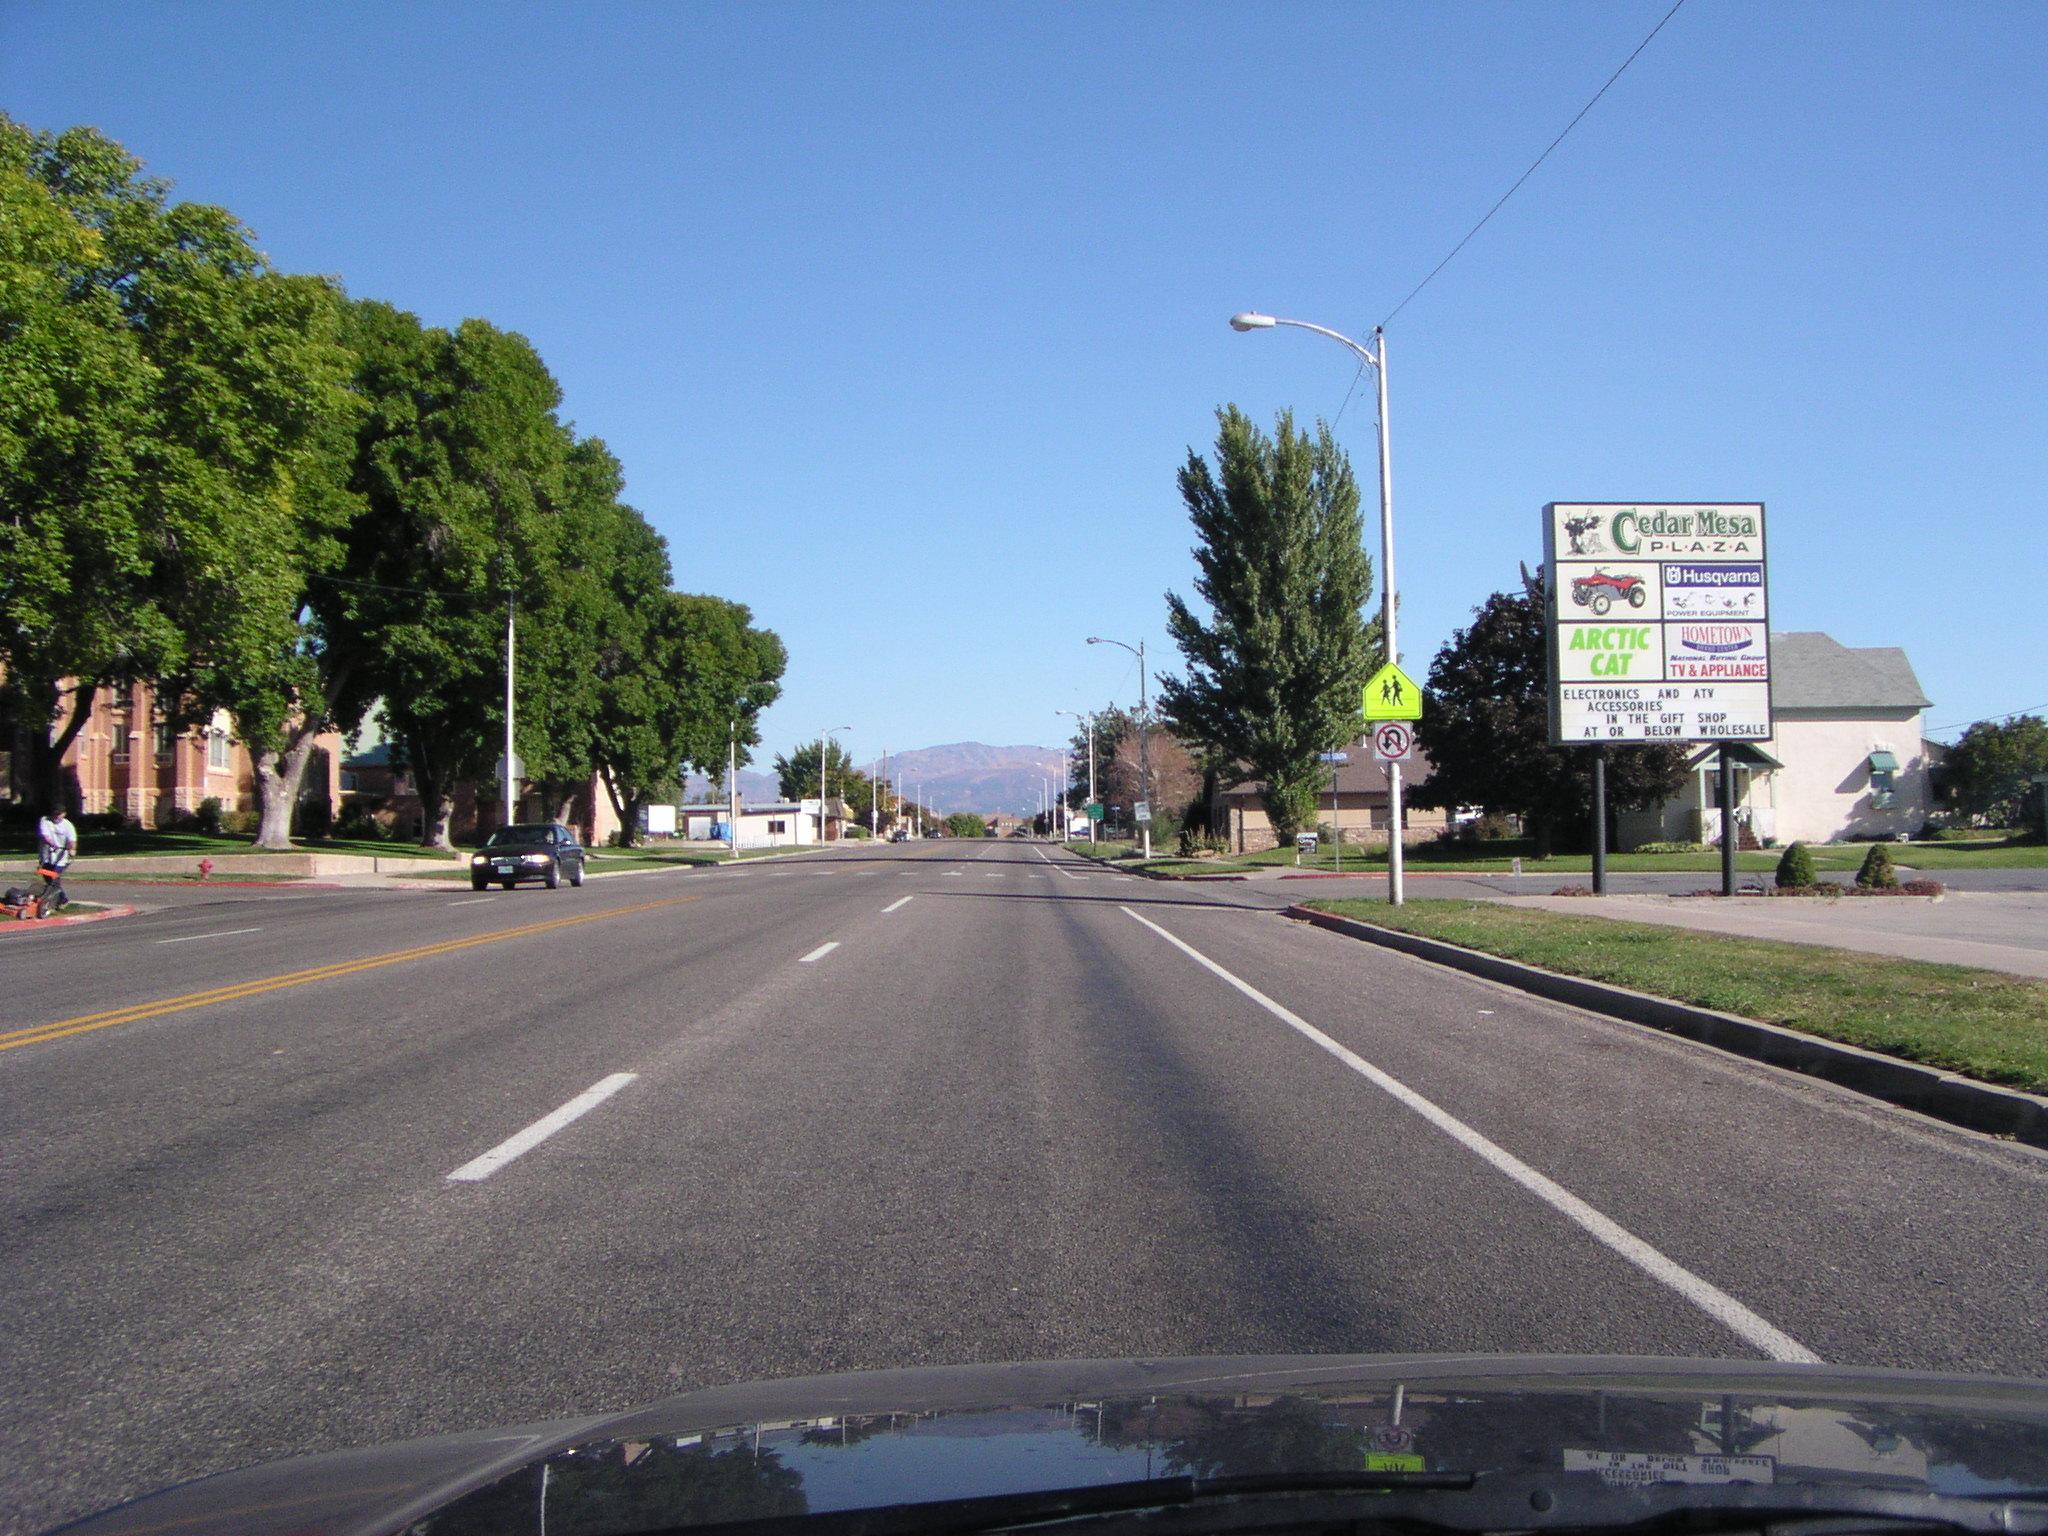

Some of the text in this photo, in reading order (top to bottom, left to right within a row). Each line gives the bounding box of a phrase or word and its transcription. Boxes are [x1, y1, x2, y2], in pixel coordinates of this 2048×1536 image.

[1611, 508, 1757, 554] Cedar Mesa
[1683, 569, 1760, 586] Husqvarna
[1569, 627, 1651, 650] ARCTIC
[1682, 626, 1753, 646] HOMETOWN
[1590, 653, 1635, 676] CAT
[1670, 664, 1766, 677] TV & APPLIANCE
[1564, 689, 1714, 700] ELECTRONICS AND ATV
[1587, 702, 1662, 711] ACCESSORIES
[1606, 713, 1727, 724] IN THE GIFT SHOP
[1584, 725, 1766, 737] AT OR BELOW WHOLESALE
